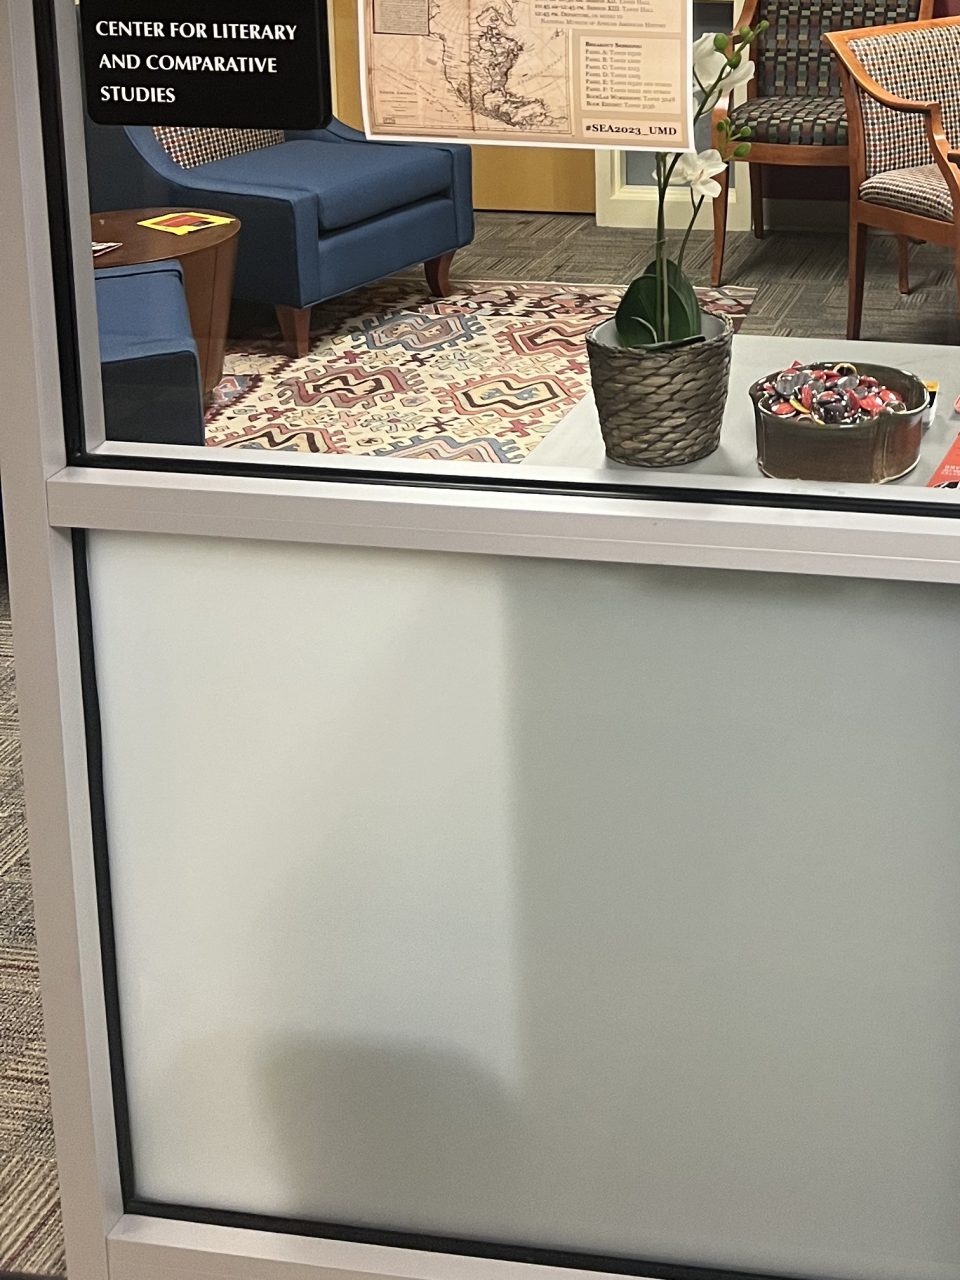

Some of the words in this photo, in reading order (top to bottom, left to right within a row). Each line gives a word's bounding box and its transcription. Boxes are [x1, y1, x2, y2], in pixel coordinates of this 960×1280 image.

[96, 20, 164, 37] CENTER
[170, 22, 207, 38] FOR
[213, 23, 297, 40] LITERARY
[99, 54, 140, 69] AND
[146, 55, 277, 73] COMPARATIVE
[100, 86, 175, 102] STUDIES
[585, 124, 677, 135] #SEA2023_UMD
